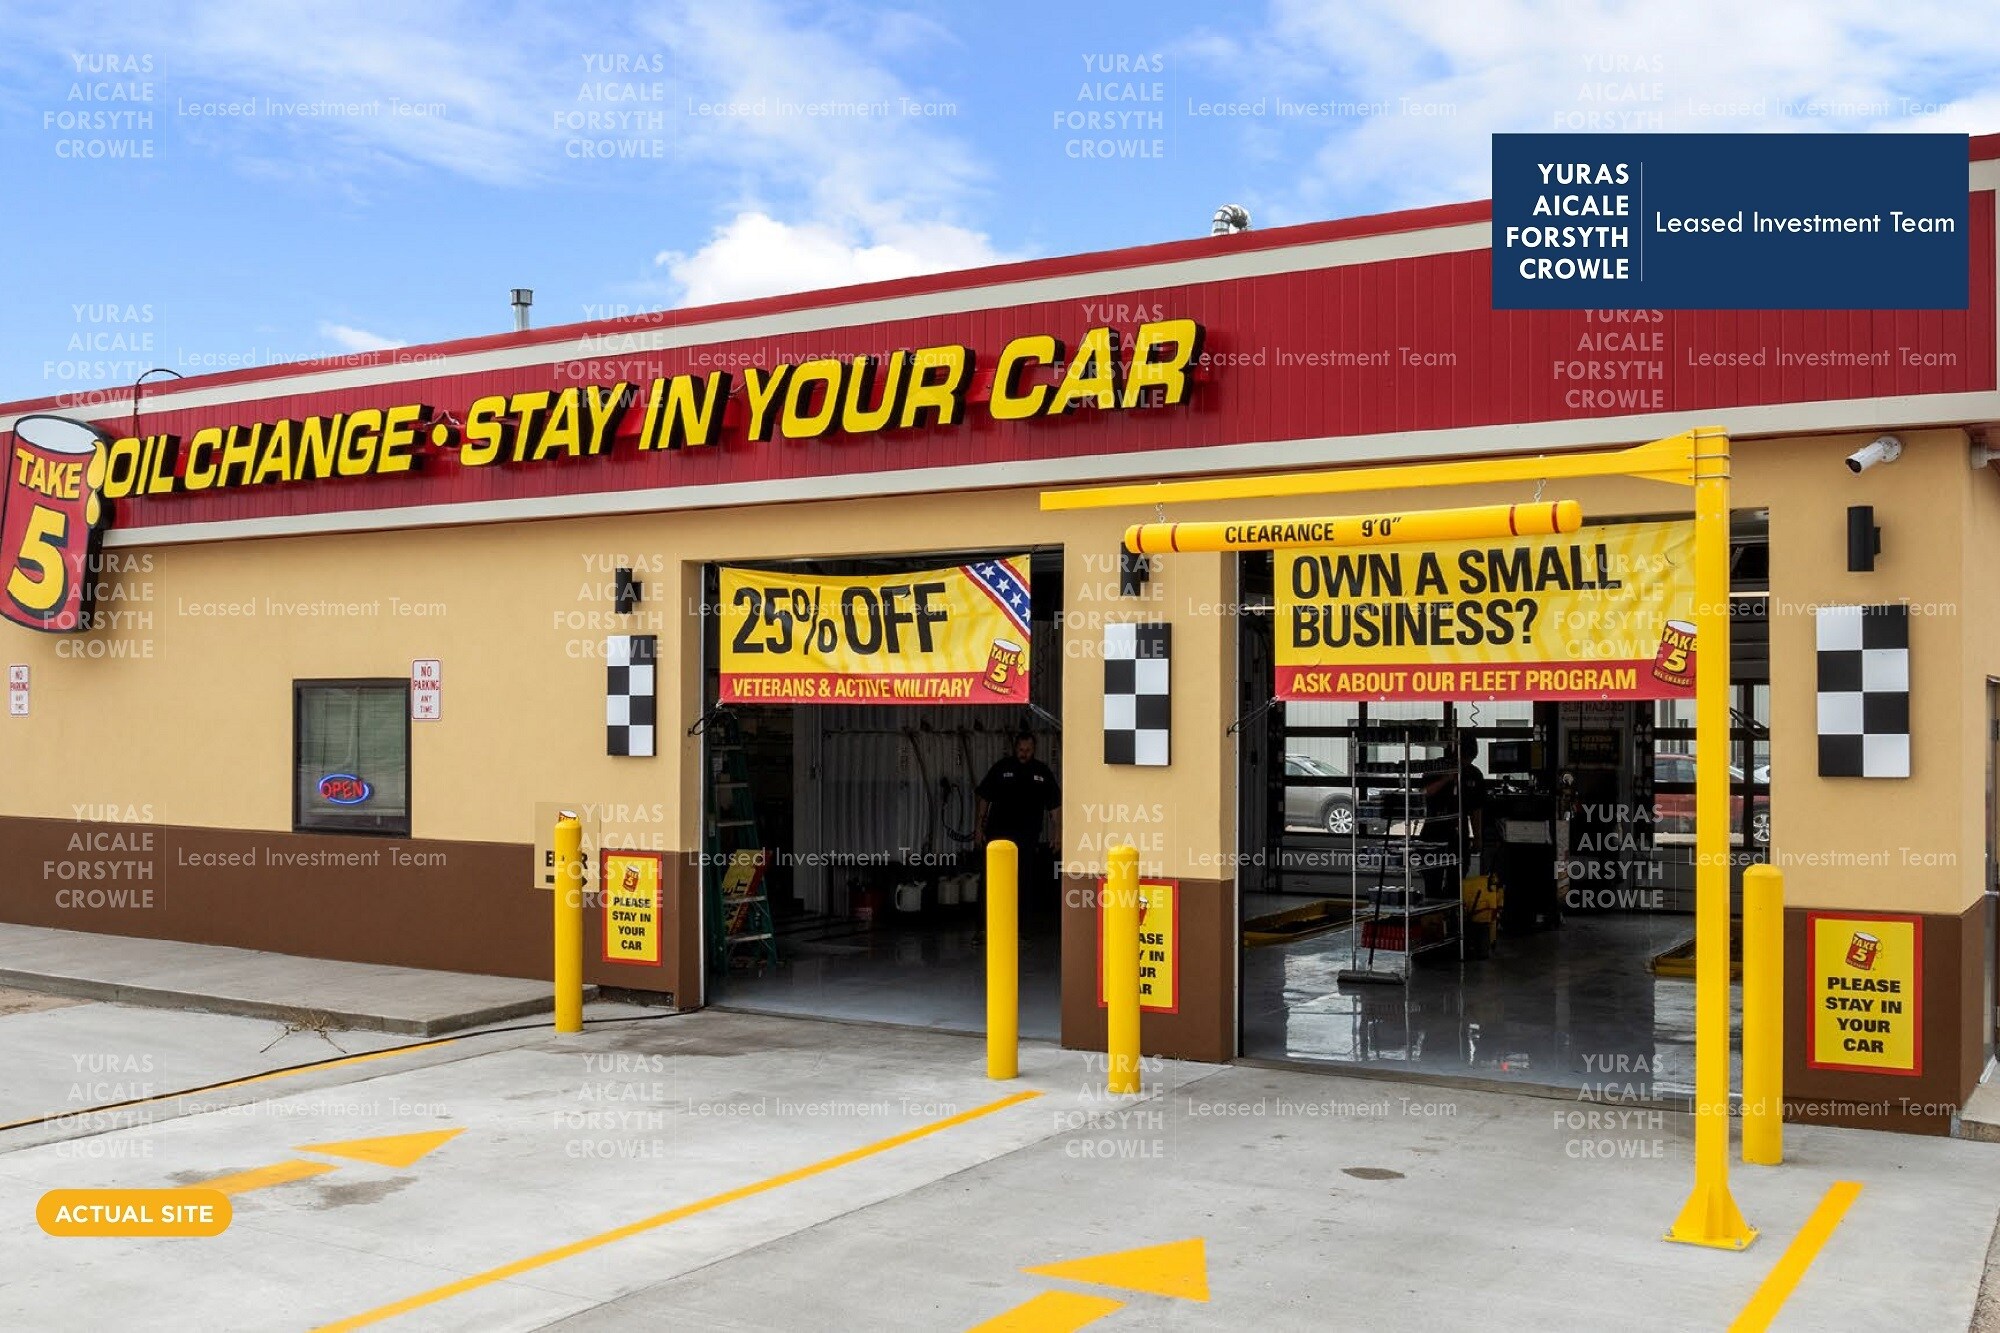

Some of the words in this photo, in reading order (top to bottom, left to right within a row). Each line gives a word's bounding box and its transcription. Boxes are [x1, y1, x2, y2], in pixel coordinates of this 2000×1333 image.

[104, 434, 174, 498] OIL
[185, 404, 421, 490] CHANGE
[460, 382, 629, 466] STAY
[639, 370, 722, 450] IN
[744, 345, 966, 441] YOUR
[990, 318, 1199, 420] CAR
[16, 447, 83, 499] TAKE
[1225, 523, 1335, 543] CLEARANCE
[7, 503, 67, 610] 5
[1292, 553, 1402, 599] OWN
[1415, 552, 1449, 596] A
[1458, 544, 1622, 594] SMALL
[732, 586, 838, 656] 25%
[841, 582, 948, 655] OFF
[1292, 598, 1538, 648] BUSINESS?
[1663, 627, 1697, 652] TAKE
[991, 645, 1017, 666] TAKE
[1663, 648, 1687, 673] 5
[420, 665, 432, 677] NO
[990, 662, 1008, 684] 5
[413, 680, 440, 690] PARKING
[732, 678, 816, 698] VETERANS
[818, 678, 831, 698] &
[835, 678, 890, 698] ACTIVE
[894, 677, 974, 698] MILITARY
[1292, 673, 1332, 693] ASK
[1337, 672, 1407, 692] ABOUT
[1412, 672, 1454, 692] OUR
[1459, 670, 1520, 692] FLEET
[1525, 668, 1637, 690] PROGRAM
[321, 780, 363, 799] OPEN
[613, 896, 651, 908] PLEASE
[612, 911, 637, 923] STAY
[640, 913, 651, 923] IN
[618, 926, 645, 937] YOUR
[1138, 932, 1164, 945] ASE
[621, 940, 642, 951] CAR
[1149, 951, 1164, 962] IN
[1853, 950, 1868, 962] 5
[1139, 967, 1156, 978] UR
[1828, 977, 1900, 993] PLEASE
[1826, 997, 1874, 1012] STAY
[1881, 1000, 1902, 1014] IN
[1837, 1018, 1890, 1033] YOUR
[1843, 1039, 1884, 1053] CAR
